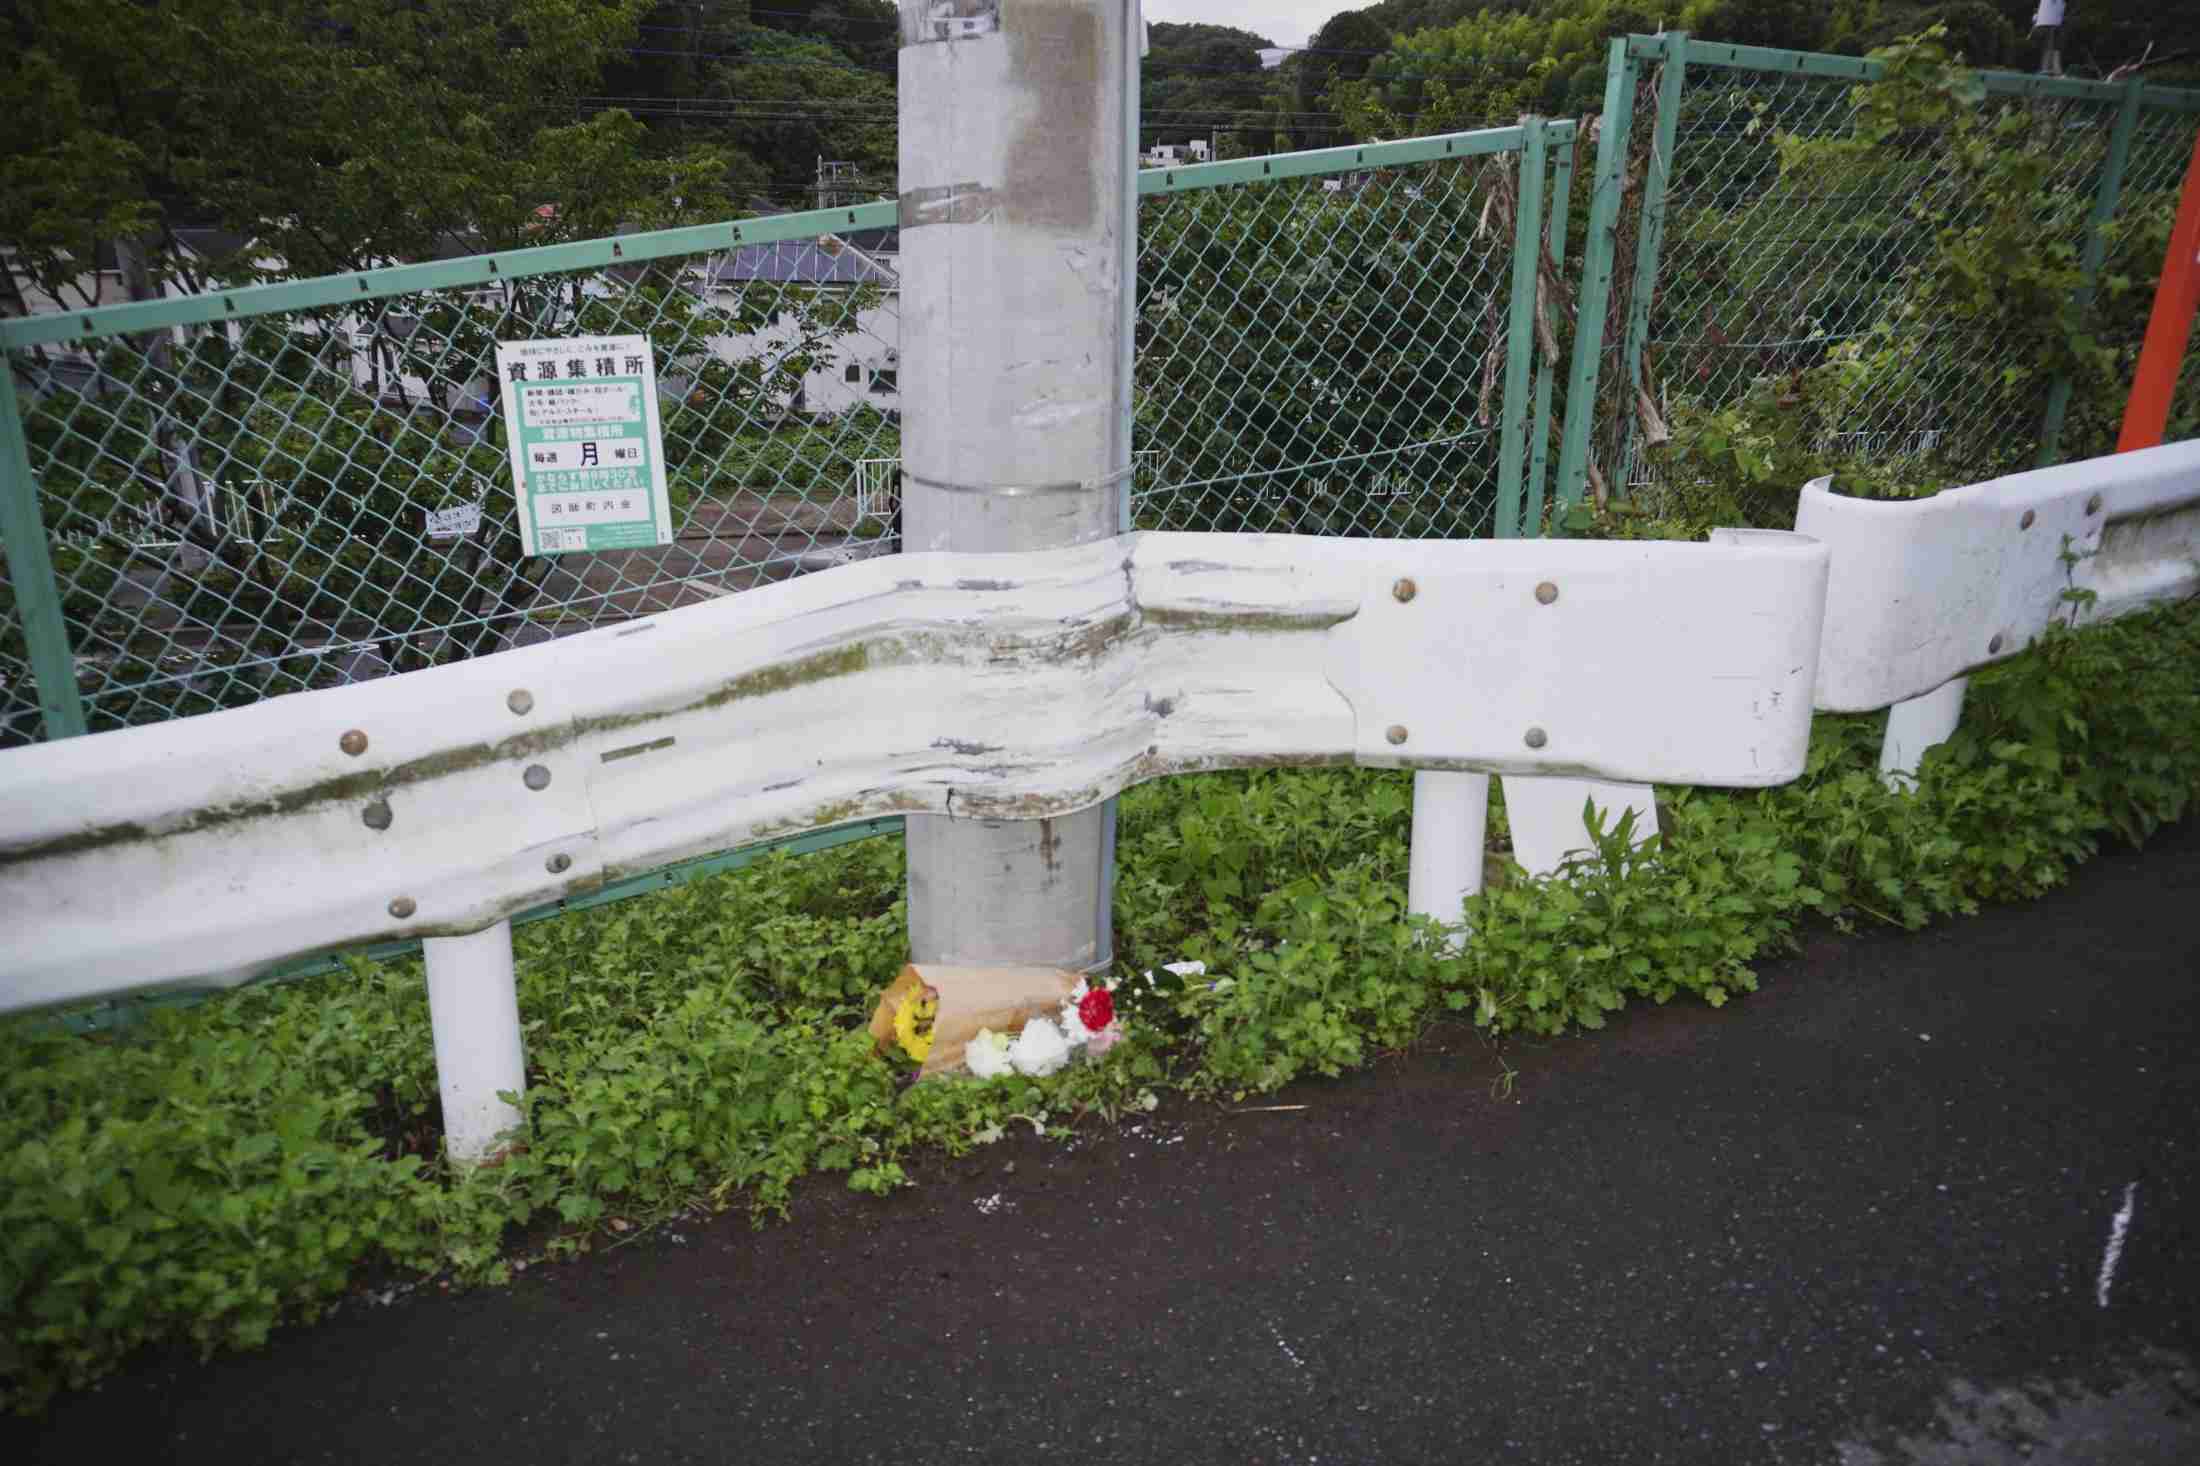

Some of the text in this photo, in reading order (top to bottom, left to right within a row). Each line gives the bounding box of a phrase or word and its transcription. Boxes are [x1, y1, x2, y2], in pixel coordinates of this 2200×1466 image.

[507, 355, 644, 382] 資源集積所
[534, 441, 639, 466] 毎週 月 曜日
